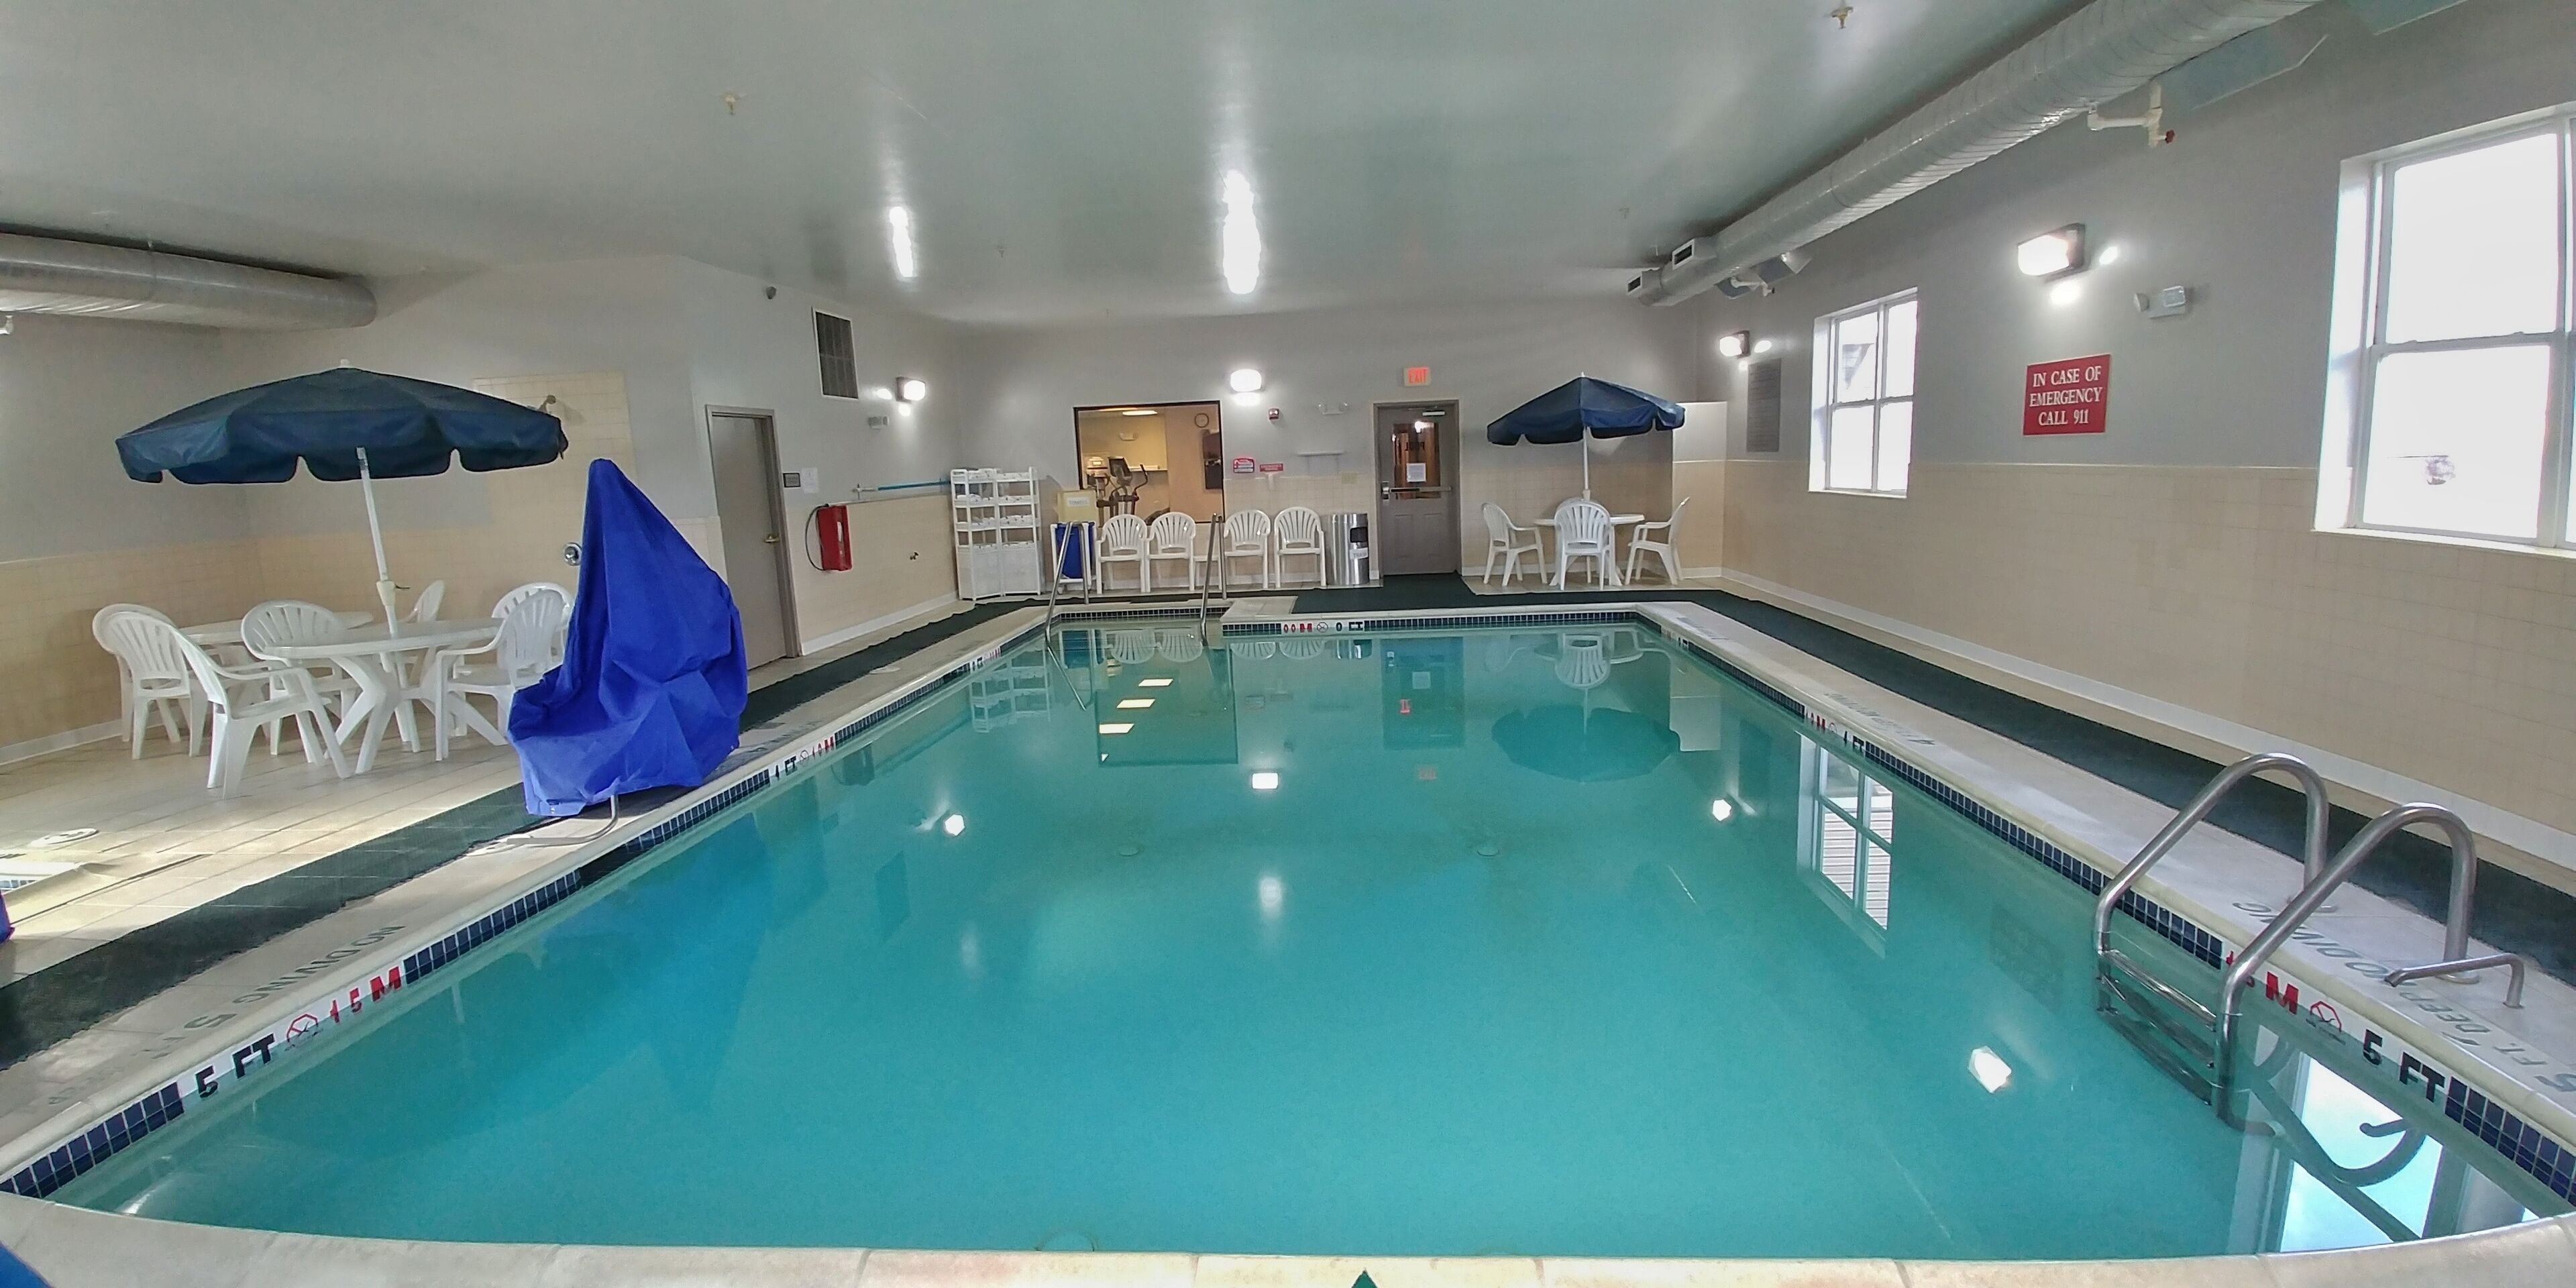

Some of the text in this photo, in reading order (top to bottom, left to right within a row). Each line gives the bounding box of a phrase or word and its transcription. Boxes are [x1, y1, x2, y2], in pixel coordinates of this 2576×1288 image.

[1408, 368, 1428, 383] EXIT
[2033, 366, 2102, 387] IN CASE OF
[2029, 387, 2103, 407] EMERGENCY
[2039, 409, 2089, 426] CALL 911
[232, 949, 361, 1004] DIVING
[370, 966, 402, 1002] M
[2265, 971, 2300, 1015] M
[2399, 991, 2491, 1033] DEEP
[195, 1065, 219, 1098] 5
[232, 1033, 275, 1079] FT
[2363, 1028, 2446, 1104] 5 FT
